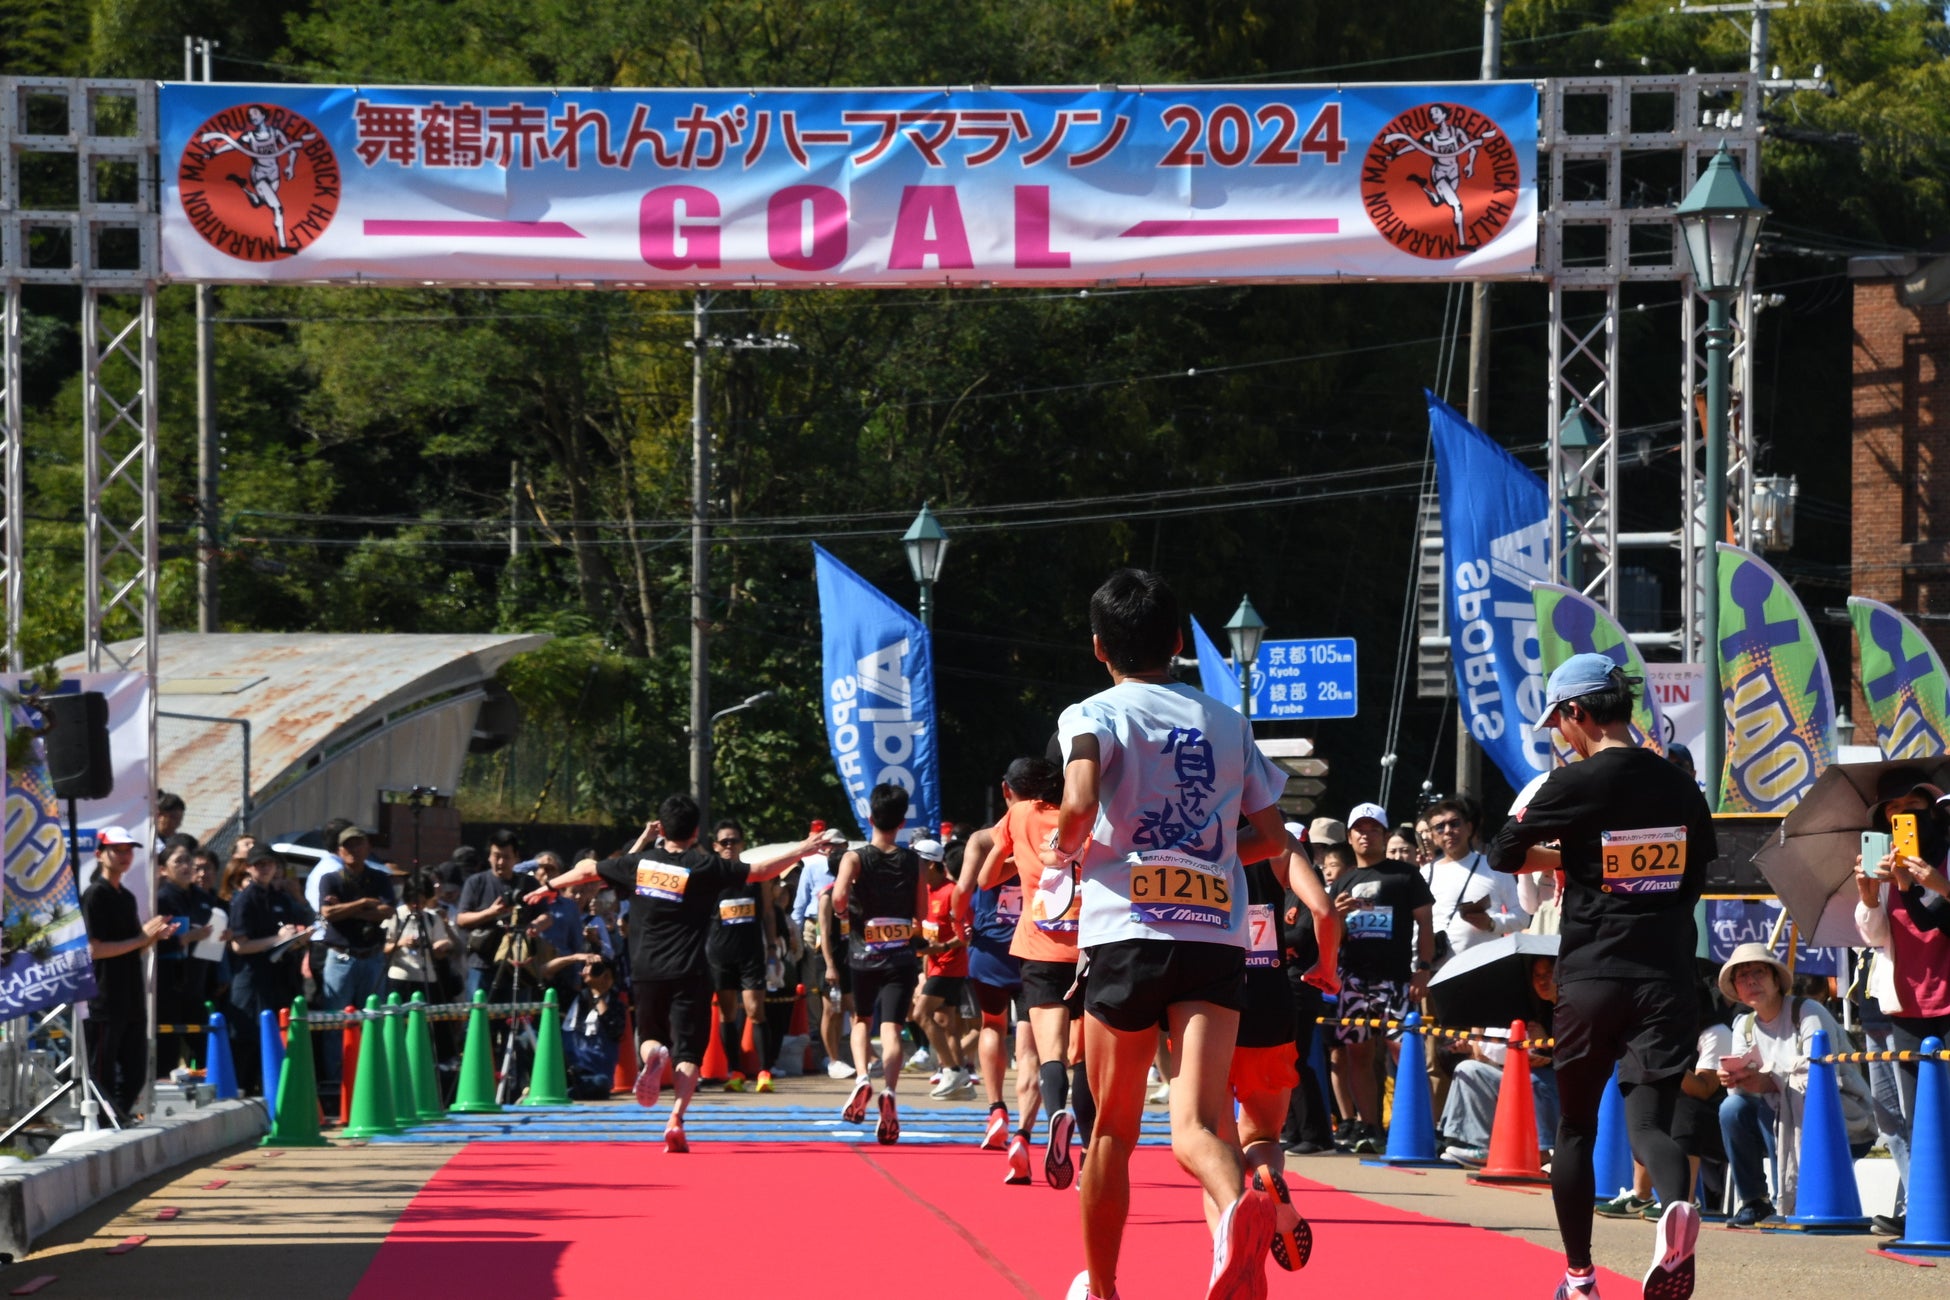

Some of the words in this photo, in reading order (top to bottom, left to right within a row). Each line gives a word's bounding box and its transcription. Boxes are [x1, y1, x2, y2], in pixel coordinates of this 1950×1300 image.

[355, 101, 1129, 168] 舞鶴赤れんがハーフマラソン
[1156, 102, 1347, 167] 2024
[304, 139, 338, 199] BRICK
[1484, 137, 1517, 195] BRICK
[182, 190, 276, 259] MARATHON
[639, 185, 1071, 271] GOAL
[1365, 192, 1455, 257] MARATHON
[1269, 646, 1307, 665] 京都
[1269, 667, 1300, 678] Kyoto
[1269, 683, 1307, 702] 綾部
[1270, 704, 1304, 715] Ayabe
[1607, 855, 1619, 872] B
[1631, 844, 1680, 871] 622
[651, 872, 680, 888] 628
[1133, 875, 1148, 896] C
[1155, 868, 1228, 903] 1215
[1171, 909, 1222, 925] MIZUNO
[875, 925, 911, 938] 1051
